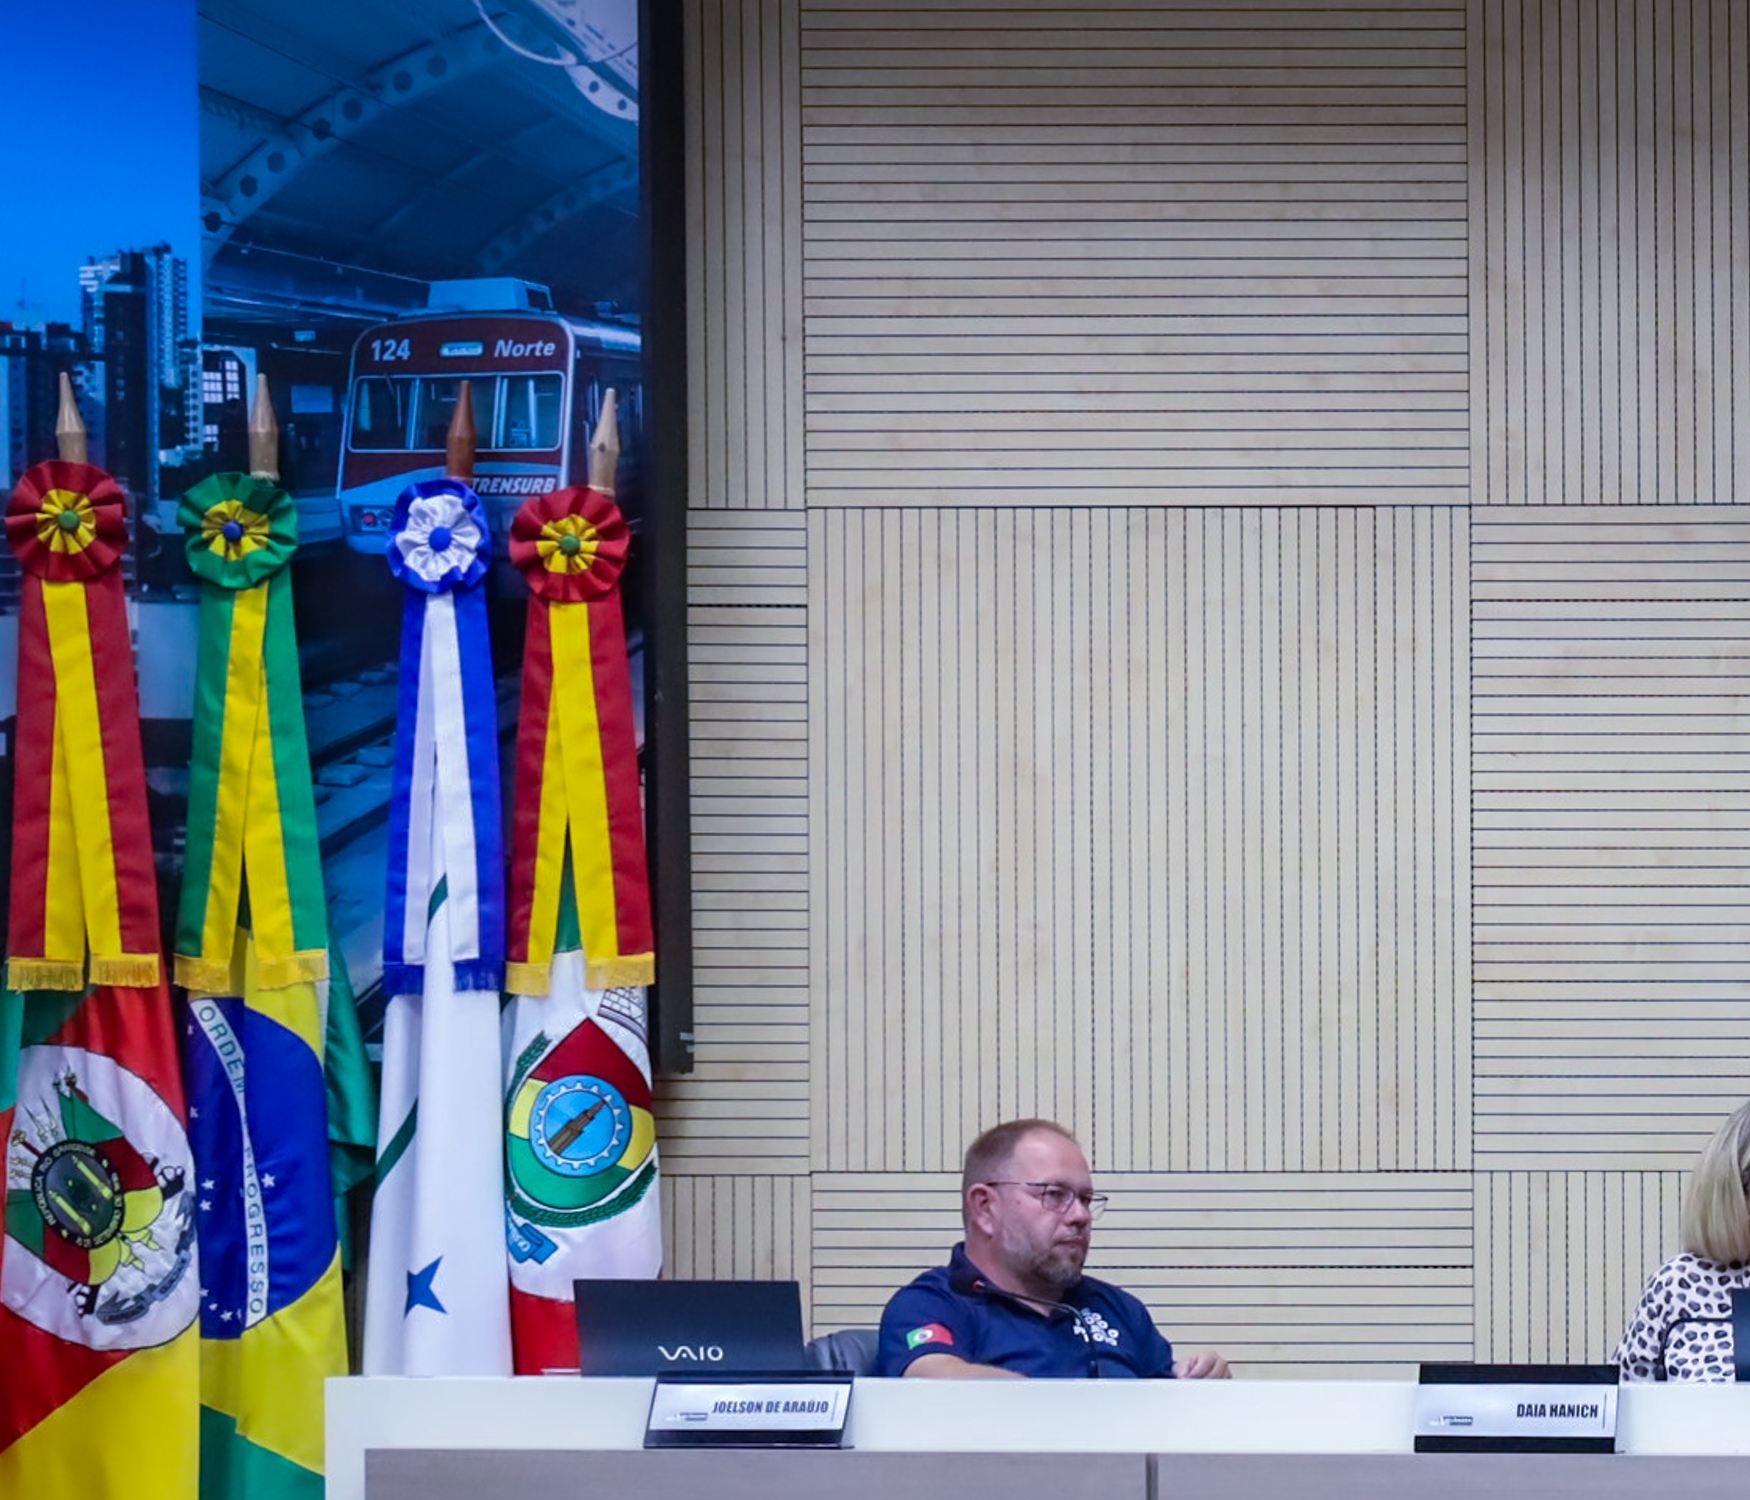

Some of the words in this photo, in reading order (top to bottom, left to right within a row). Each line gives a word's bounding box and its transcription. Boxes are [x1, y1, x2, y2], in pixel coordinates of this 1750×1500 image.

[371, 339, 411, 361] 124
[494, 339, 556, 358] Norte
[658, 1346, 724, 1362] VAIO
[712, 1400, 763, 1414] JOELSON
[765, 1401, 780, 1413] DE
[782, 1399, 829, 1414] ARAÚJO
[1516, 1403, 1546, 1418] DAIA
[1549, 1403, 1599, 1419] HANICH
